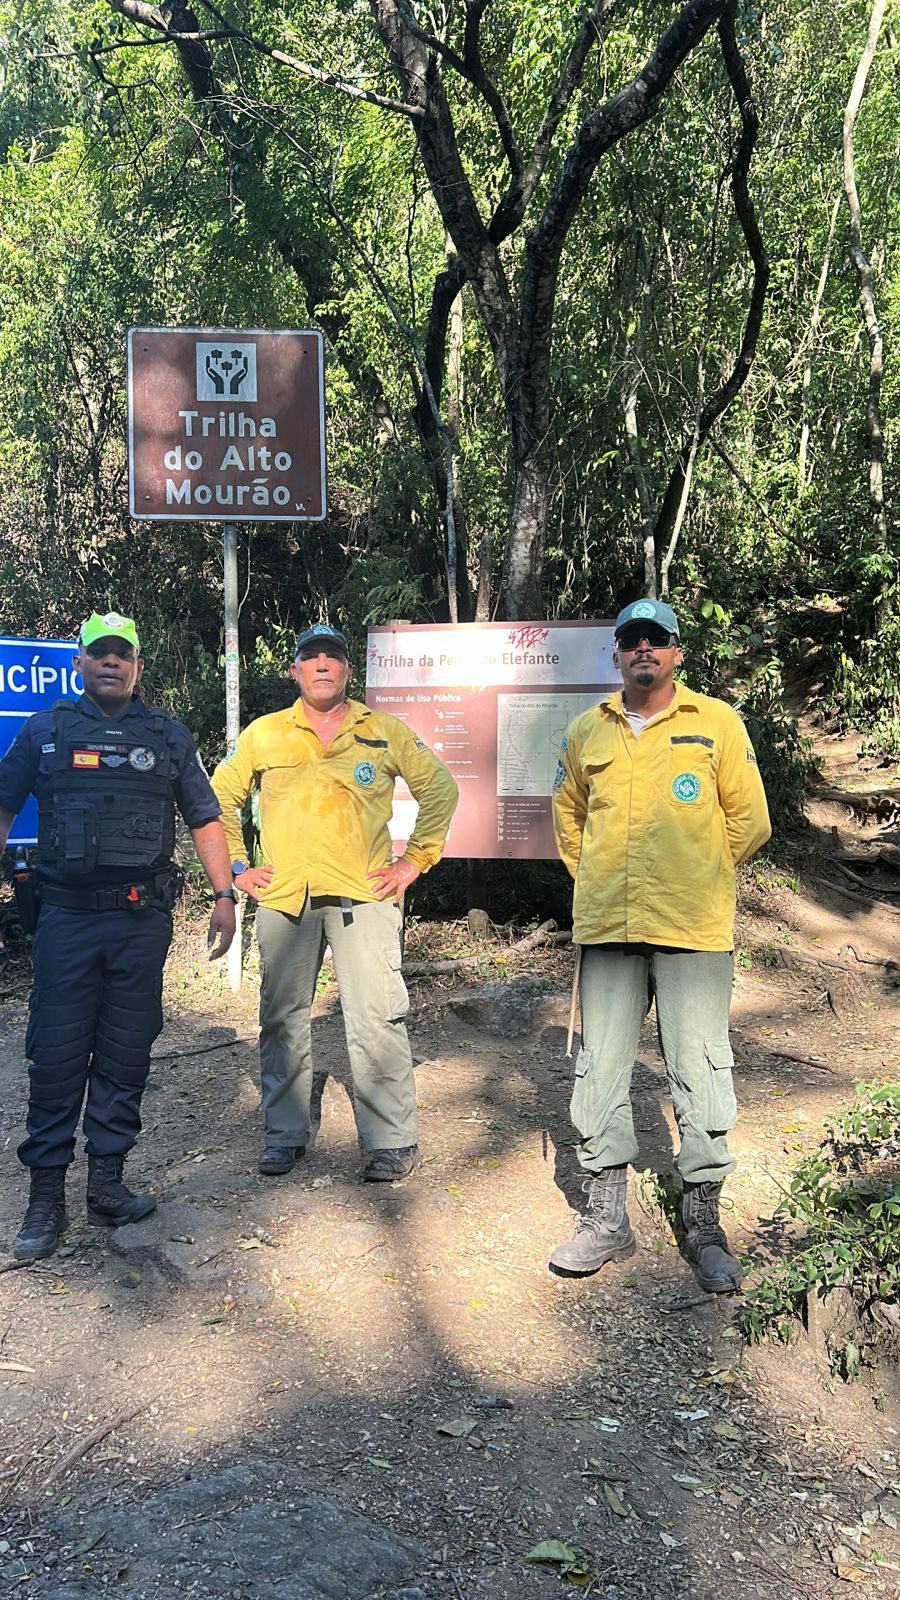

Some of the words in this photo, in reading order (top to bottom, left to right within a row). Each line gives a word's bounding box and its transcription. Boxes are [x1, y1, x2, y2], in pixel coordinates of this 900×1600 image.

[178, 410, 277, 438] Trilha
[163, 445, 203, 471] do
[219, 445, 293, 471] Alto
[166, 478, 291, 506] Mourão
[377, 654, 414, 668] Trilha
[418, 654, 434, 667] da
[502, 651, 560, 665] Elefante
[375, 694, 404, 703] Normas
[405, 693, 415, 703] de
[417, 693, 431, 703] Uso
[433, 691, 462, 703] Público
